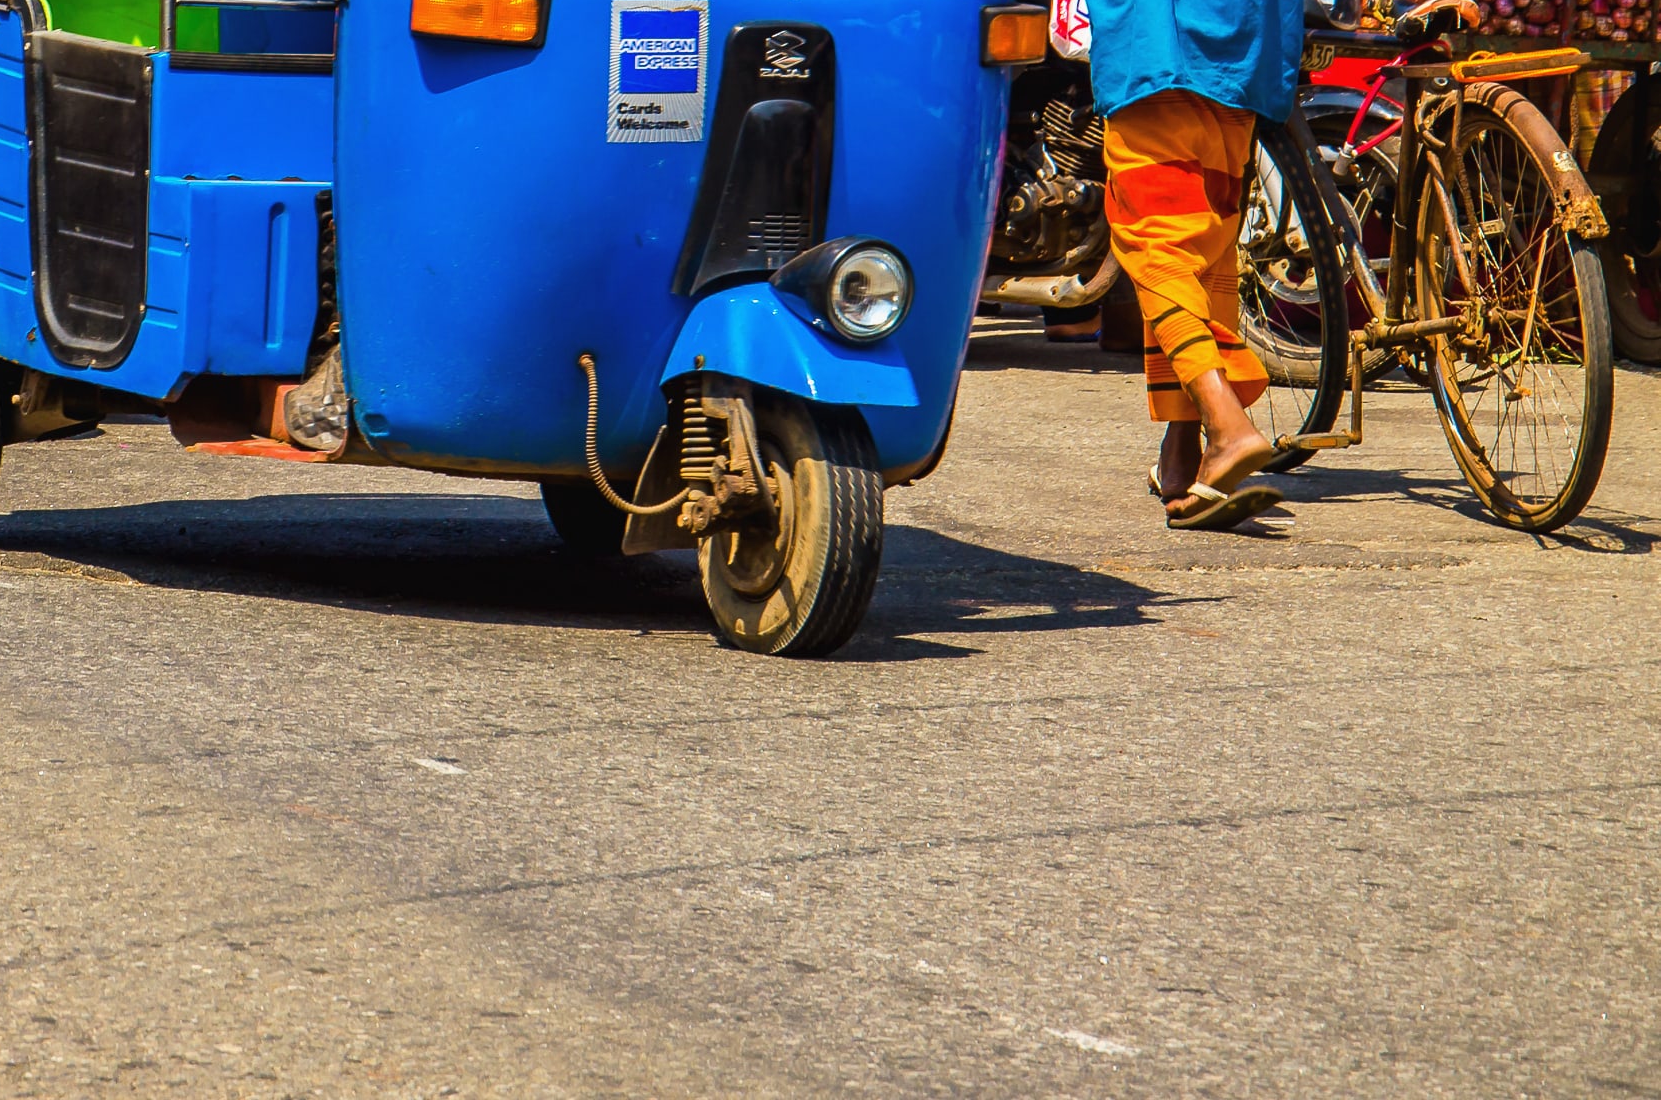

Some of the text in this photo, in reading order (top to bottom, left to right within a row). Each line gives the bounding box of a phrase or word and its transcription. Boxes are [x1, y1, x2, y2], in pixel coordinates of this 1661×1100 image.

[619, 37, 696, 54] AMERICAN
[635, 53, 699, 70] EXPRESS
[616, 102, 662, 115] Cards
[616, 117, 690, 131] Welcome
